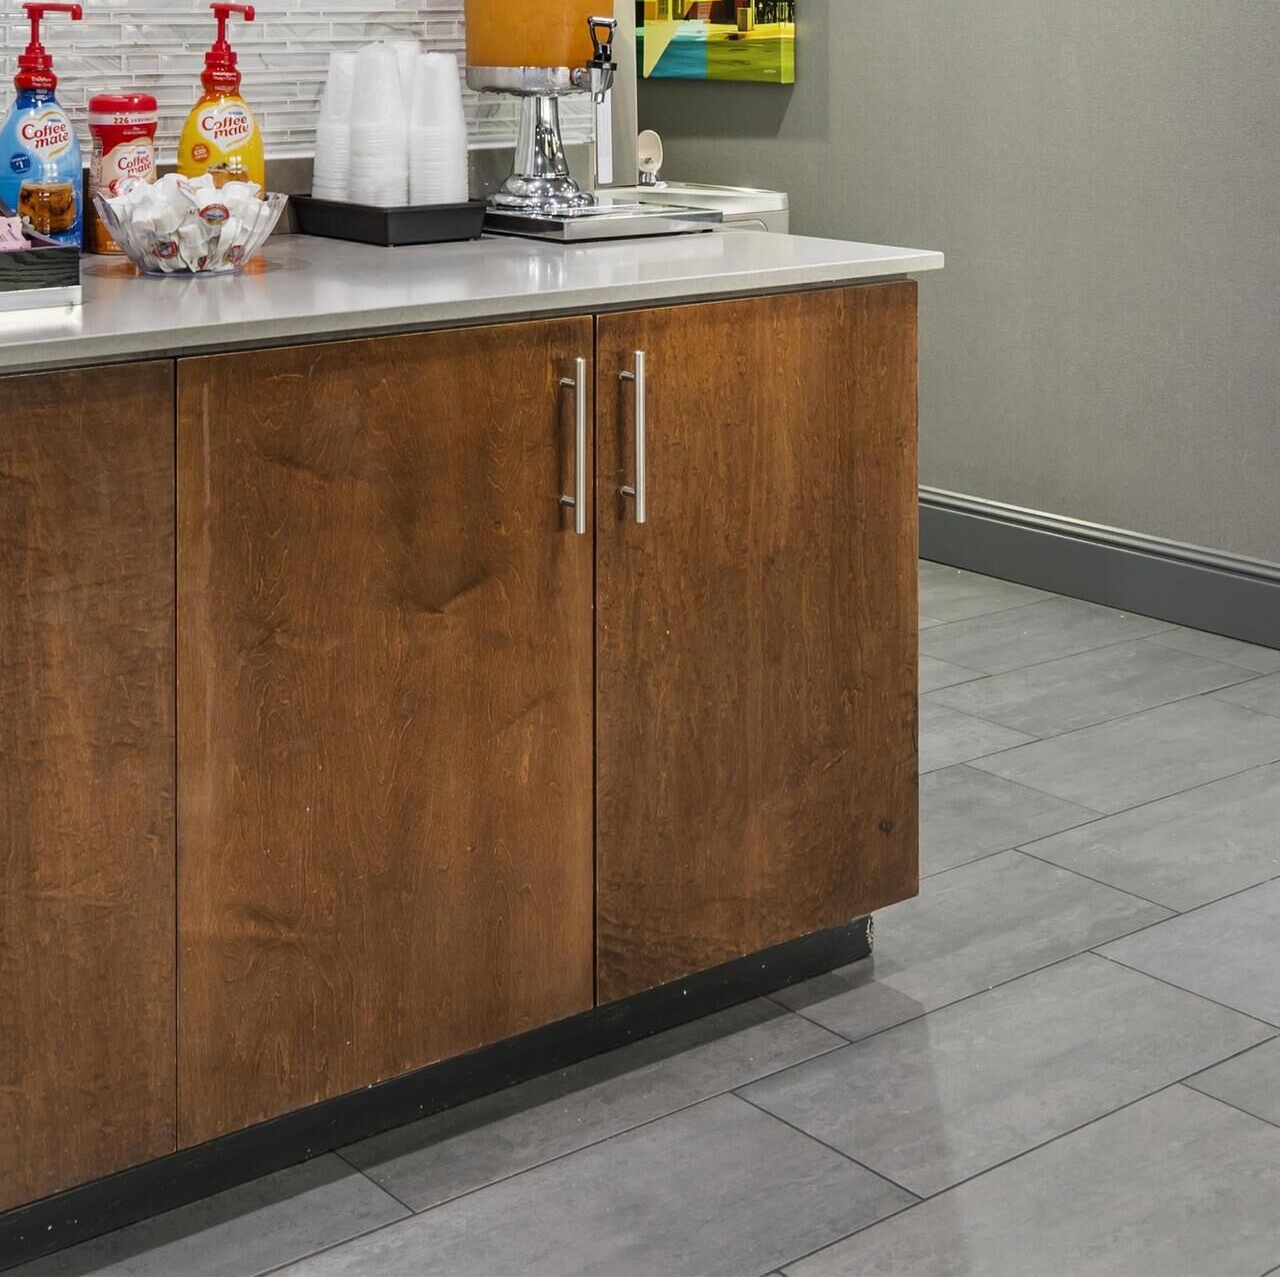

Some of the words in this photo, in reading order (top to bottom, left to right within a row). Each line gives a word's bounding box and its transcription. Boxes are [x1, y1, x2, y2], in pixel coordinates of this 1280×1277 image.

[22, 123, 66, 140] Coffee
[201, 116, 247, 131] Coffee
[214, 124, 249, 139] mate
[35, 131, 68, 149] mate
[118, 154, 150, 170] Coffee
[127, 161, 151, 177] mate
